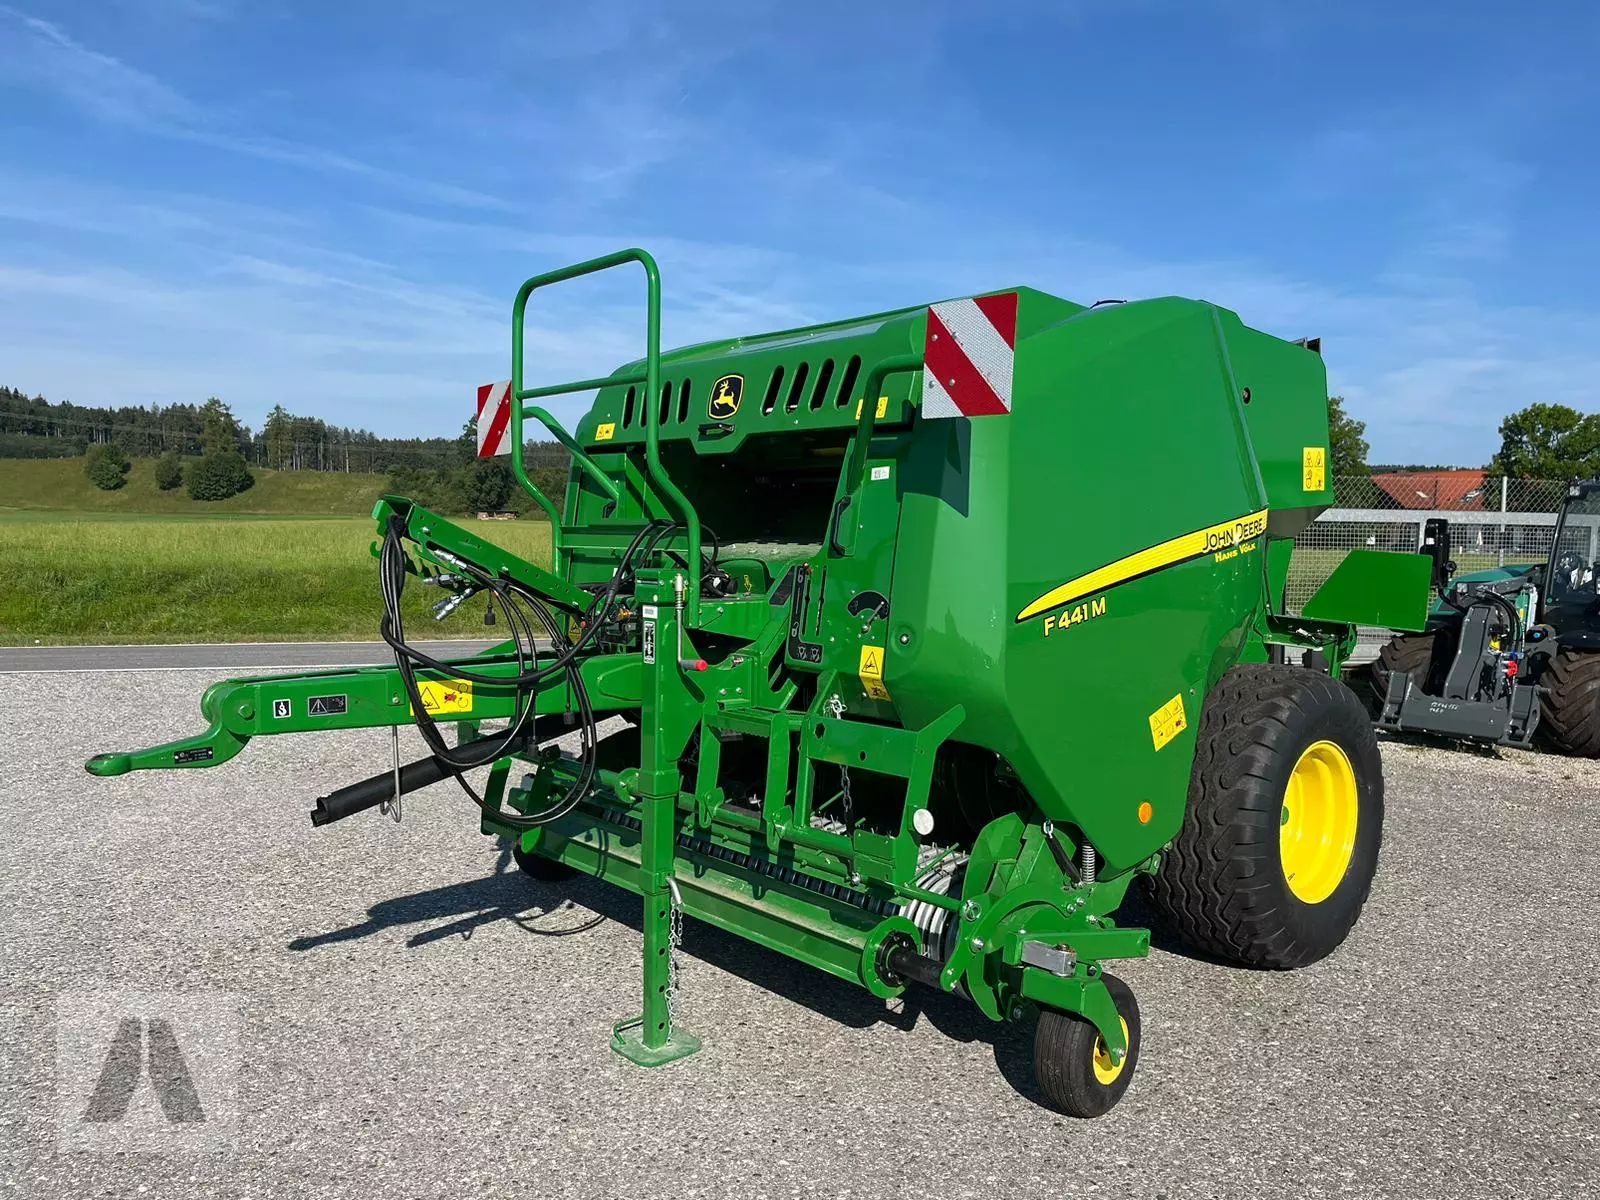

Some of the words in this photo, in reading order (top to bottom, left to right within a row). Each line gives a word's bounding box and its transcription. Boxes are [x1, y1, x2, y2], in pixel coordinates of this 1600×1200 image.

[1203, 528, 1234, 551] JOHN
[1236, 518, 1263, 540] DEERE
[1044, 615, 1056, 637] F
[1058, 603, 1089, 629] 441
[1091, 596, 1107, 619] M
